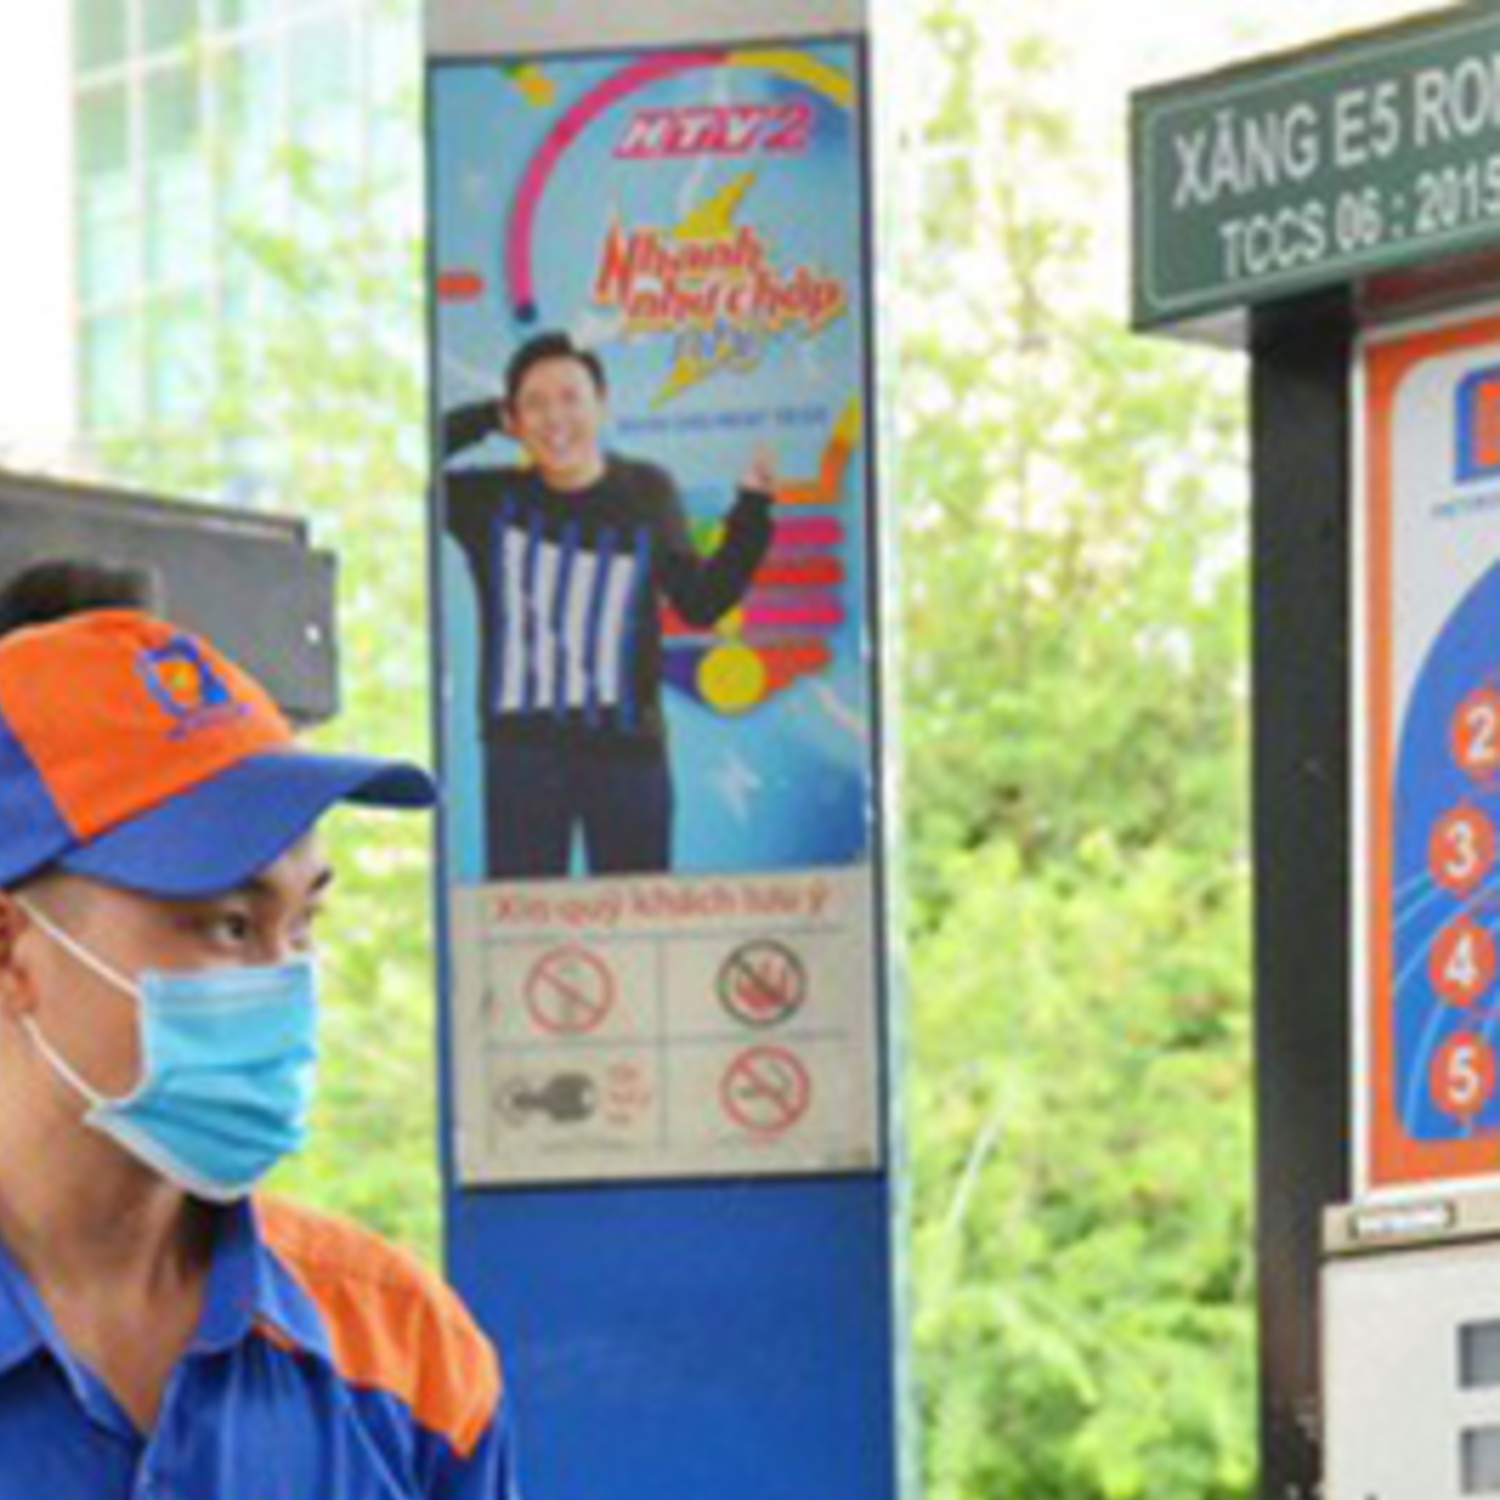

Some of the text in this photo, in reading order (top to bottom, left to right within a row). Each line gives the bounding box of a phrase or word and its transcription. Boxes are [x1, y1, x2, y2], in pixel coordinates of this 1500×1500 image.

[613, 105, 812, 158] HTV2
[1172, 52, 1500, 208] XĂNG E5 RO
[593, 214, 764, 305] Nhanh
[1218, 201, 1327, 280] TCCS
[1336, 187, 1383, 251] 06
[1464, 702, 1498, 762] 2
[1442, 820, 1479, 879] 3
[1442, 931, 1478, 985] 4
[1447, 1042, 1480, 1104] 5
